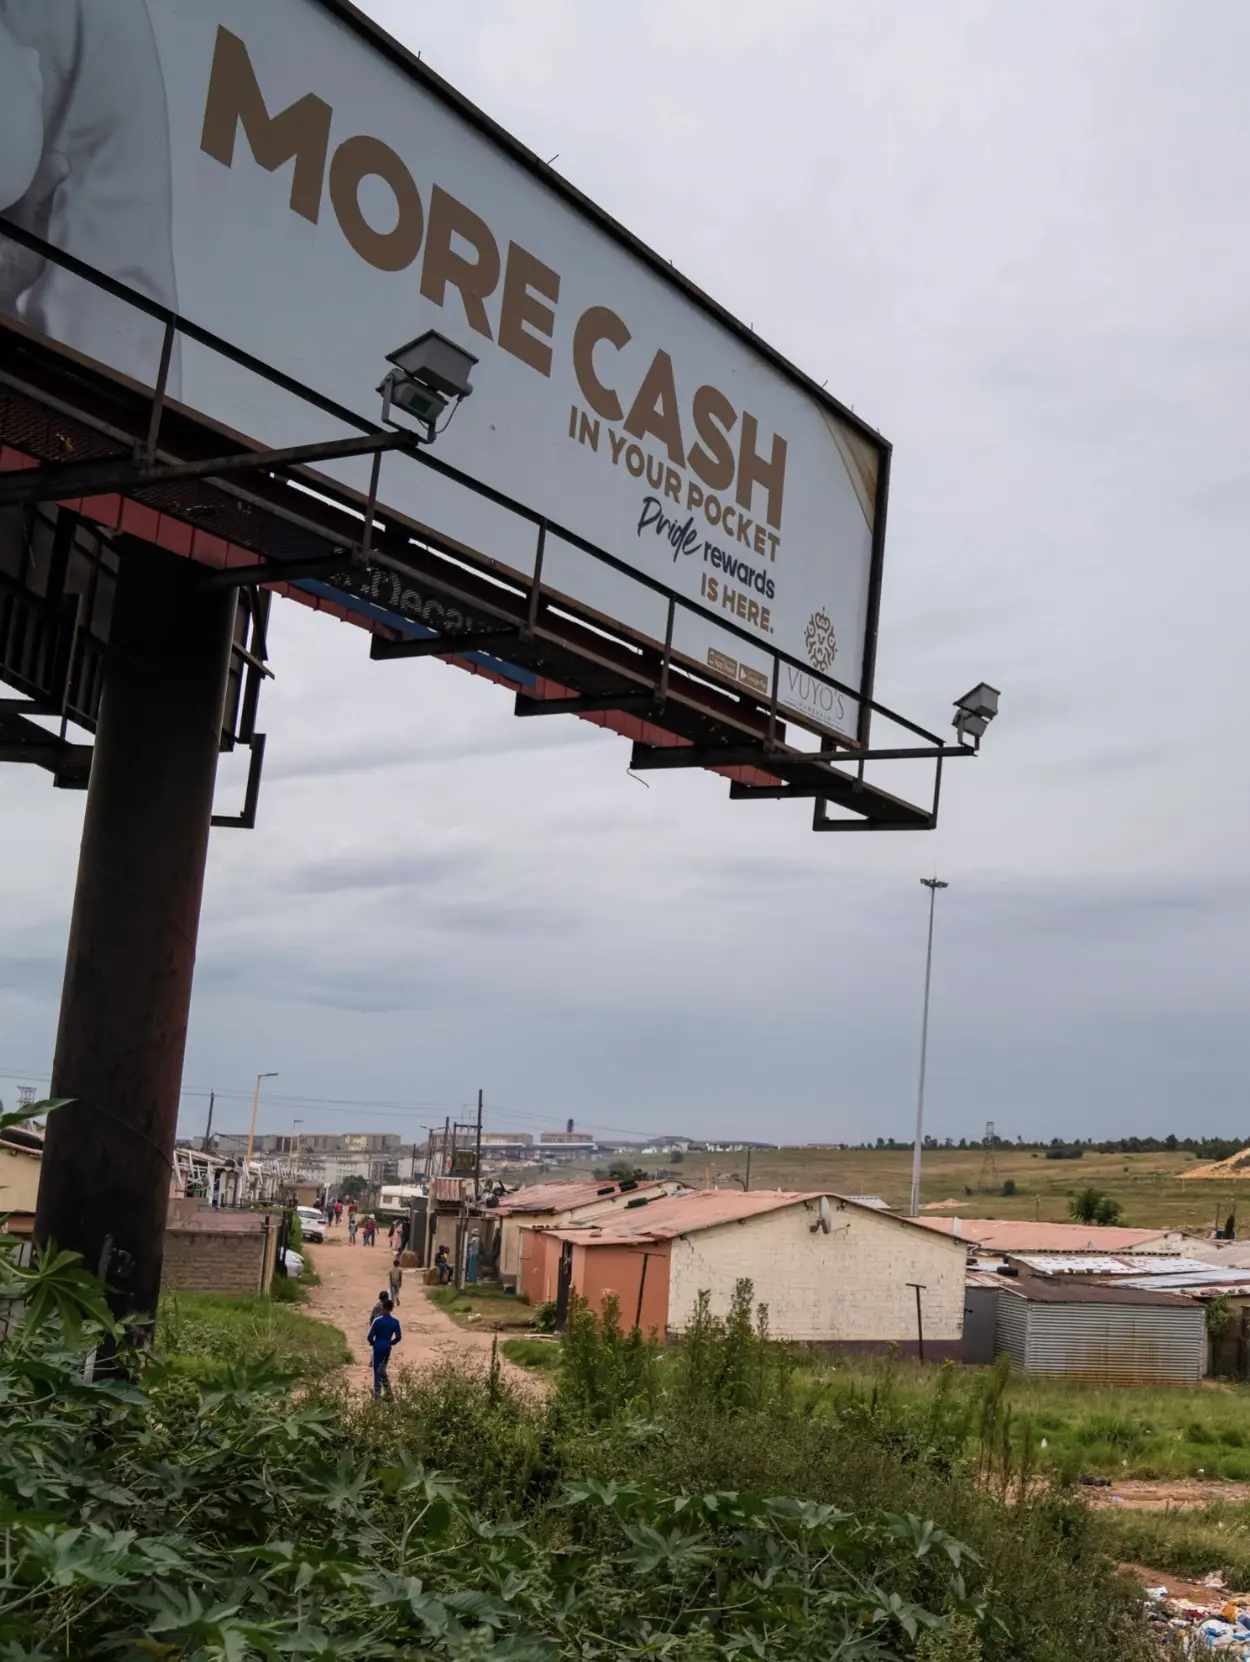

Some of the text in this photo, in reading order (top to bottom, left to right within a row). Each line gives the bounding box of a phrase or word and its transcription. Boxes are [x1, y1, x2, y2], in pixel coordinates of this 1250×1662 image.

[200, 23, 788, 531] MORE CASH
[568, 404, 781, 563] IN YOUR POCKET
[637, 496, 775, 600] Pride rewards
[701, 572, 774, 634] IS HERE.
[788, 666, 844, 720] VUYO'S
